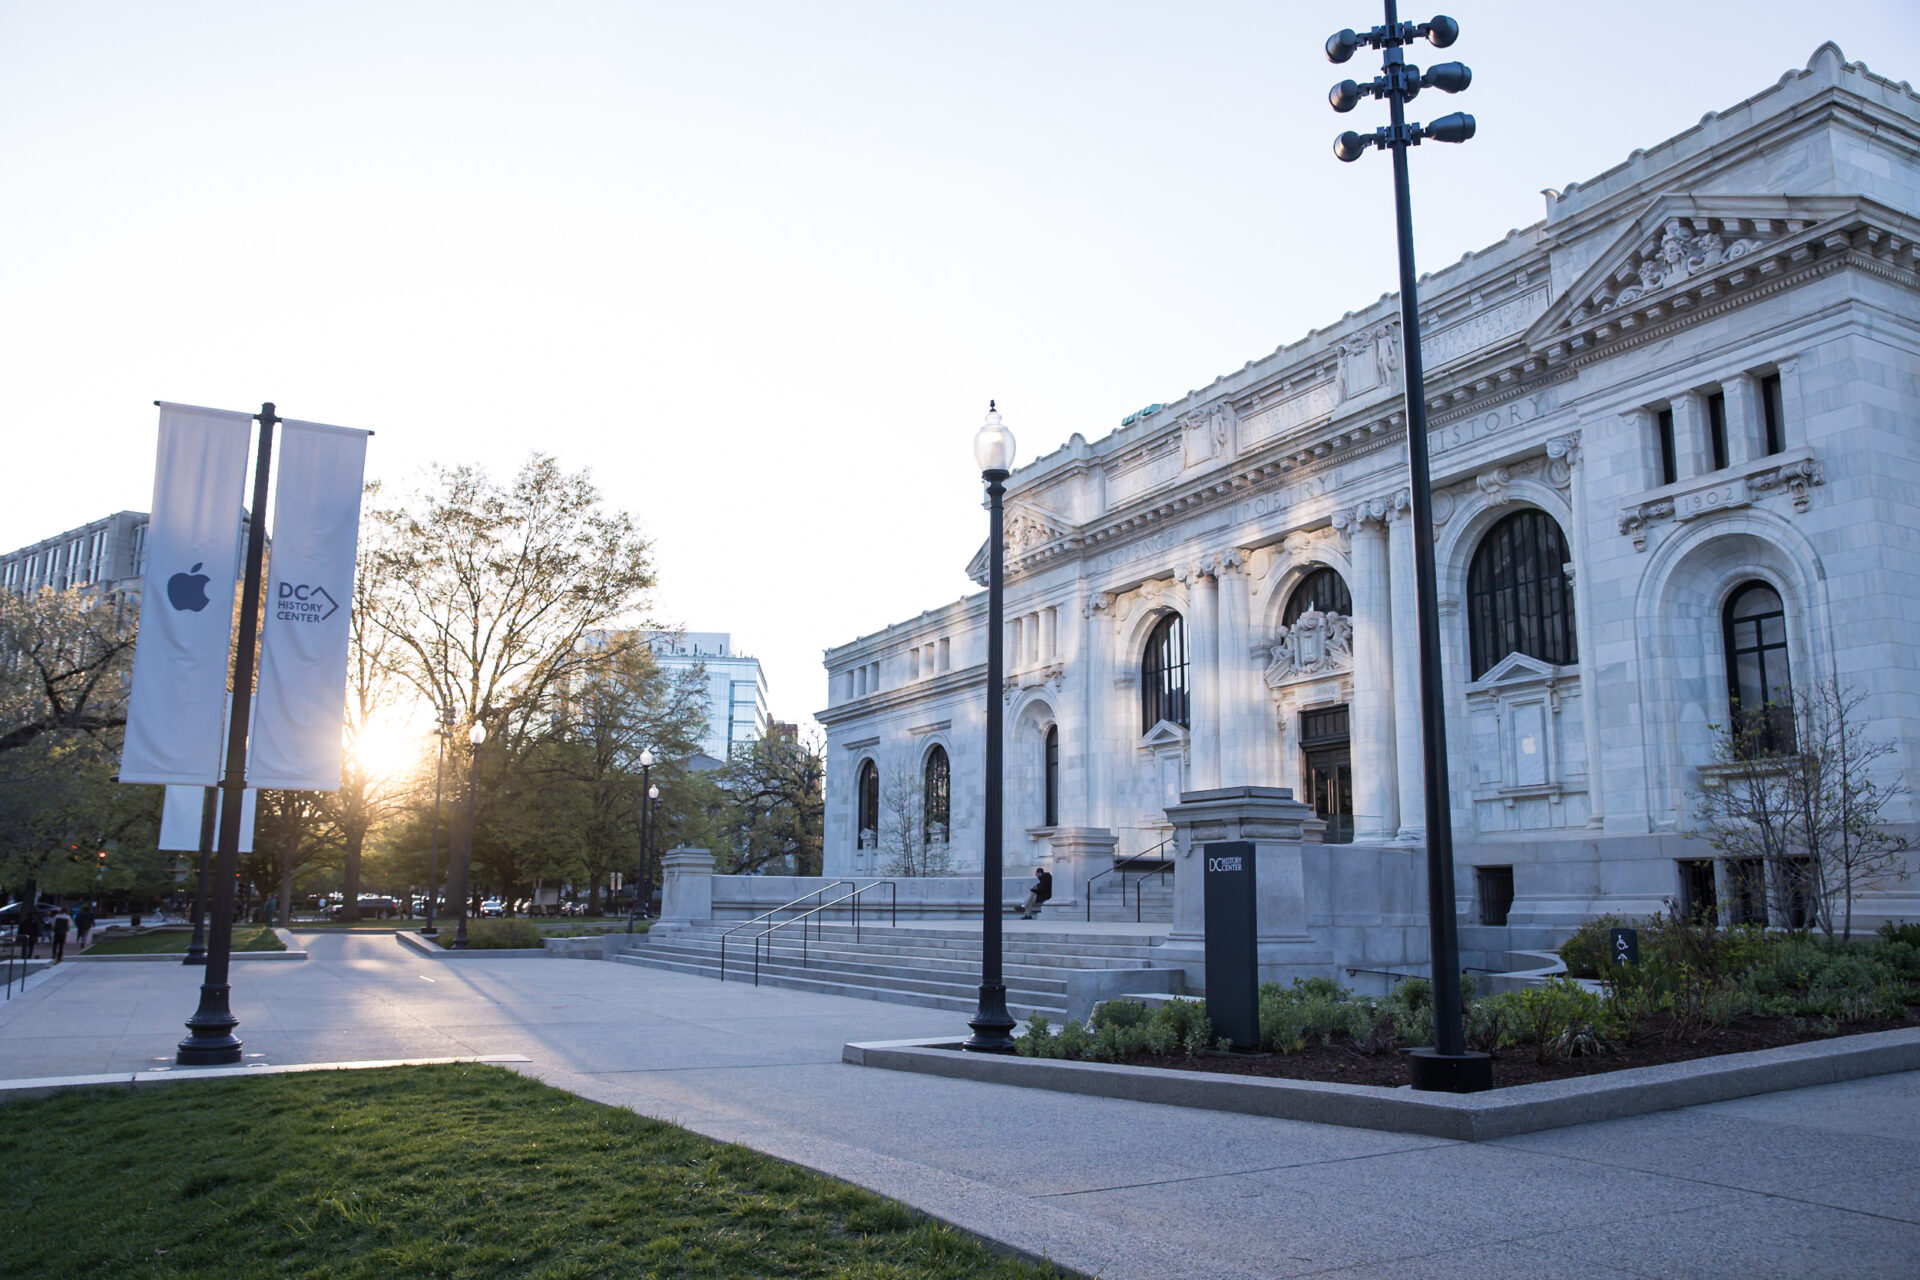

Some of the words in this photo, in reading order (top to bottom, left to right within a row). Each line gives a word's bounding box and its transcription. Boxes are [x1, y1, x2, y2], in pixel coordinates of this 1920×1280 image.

[1496, 306, 1511, 319] TO
[1519, 291, 1544, 308] THE
[1243, 473, 1330, 520] POETRY
[1684, 487, 1734, 512] 1902
[1107, 531, 1176, 569] SCIENCE
[279, 582, 309, 601] DC
[277, 600, 323, 612] HISTORY
[277, 611, 320, 623] CENTER
[1209, 857, 1222, 872] DC
